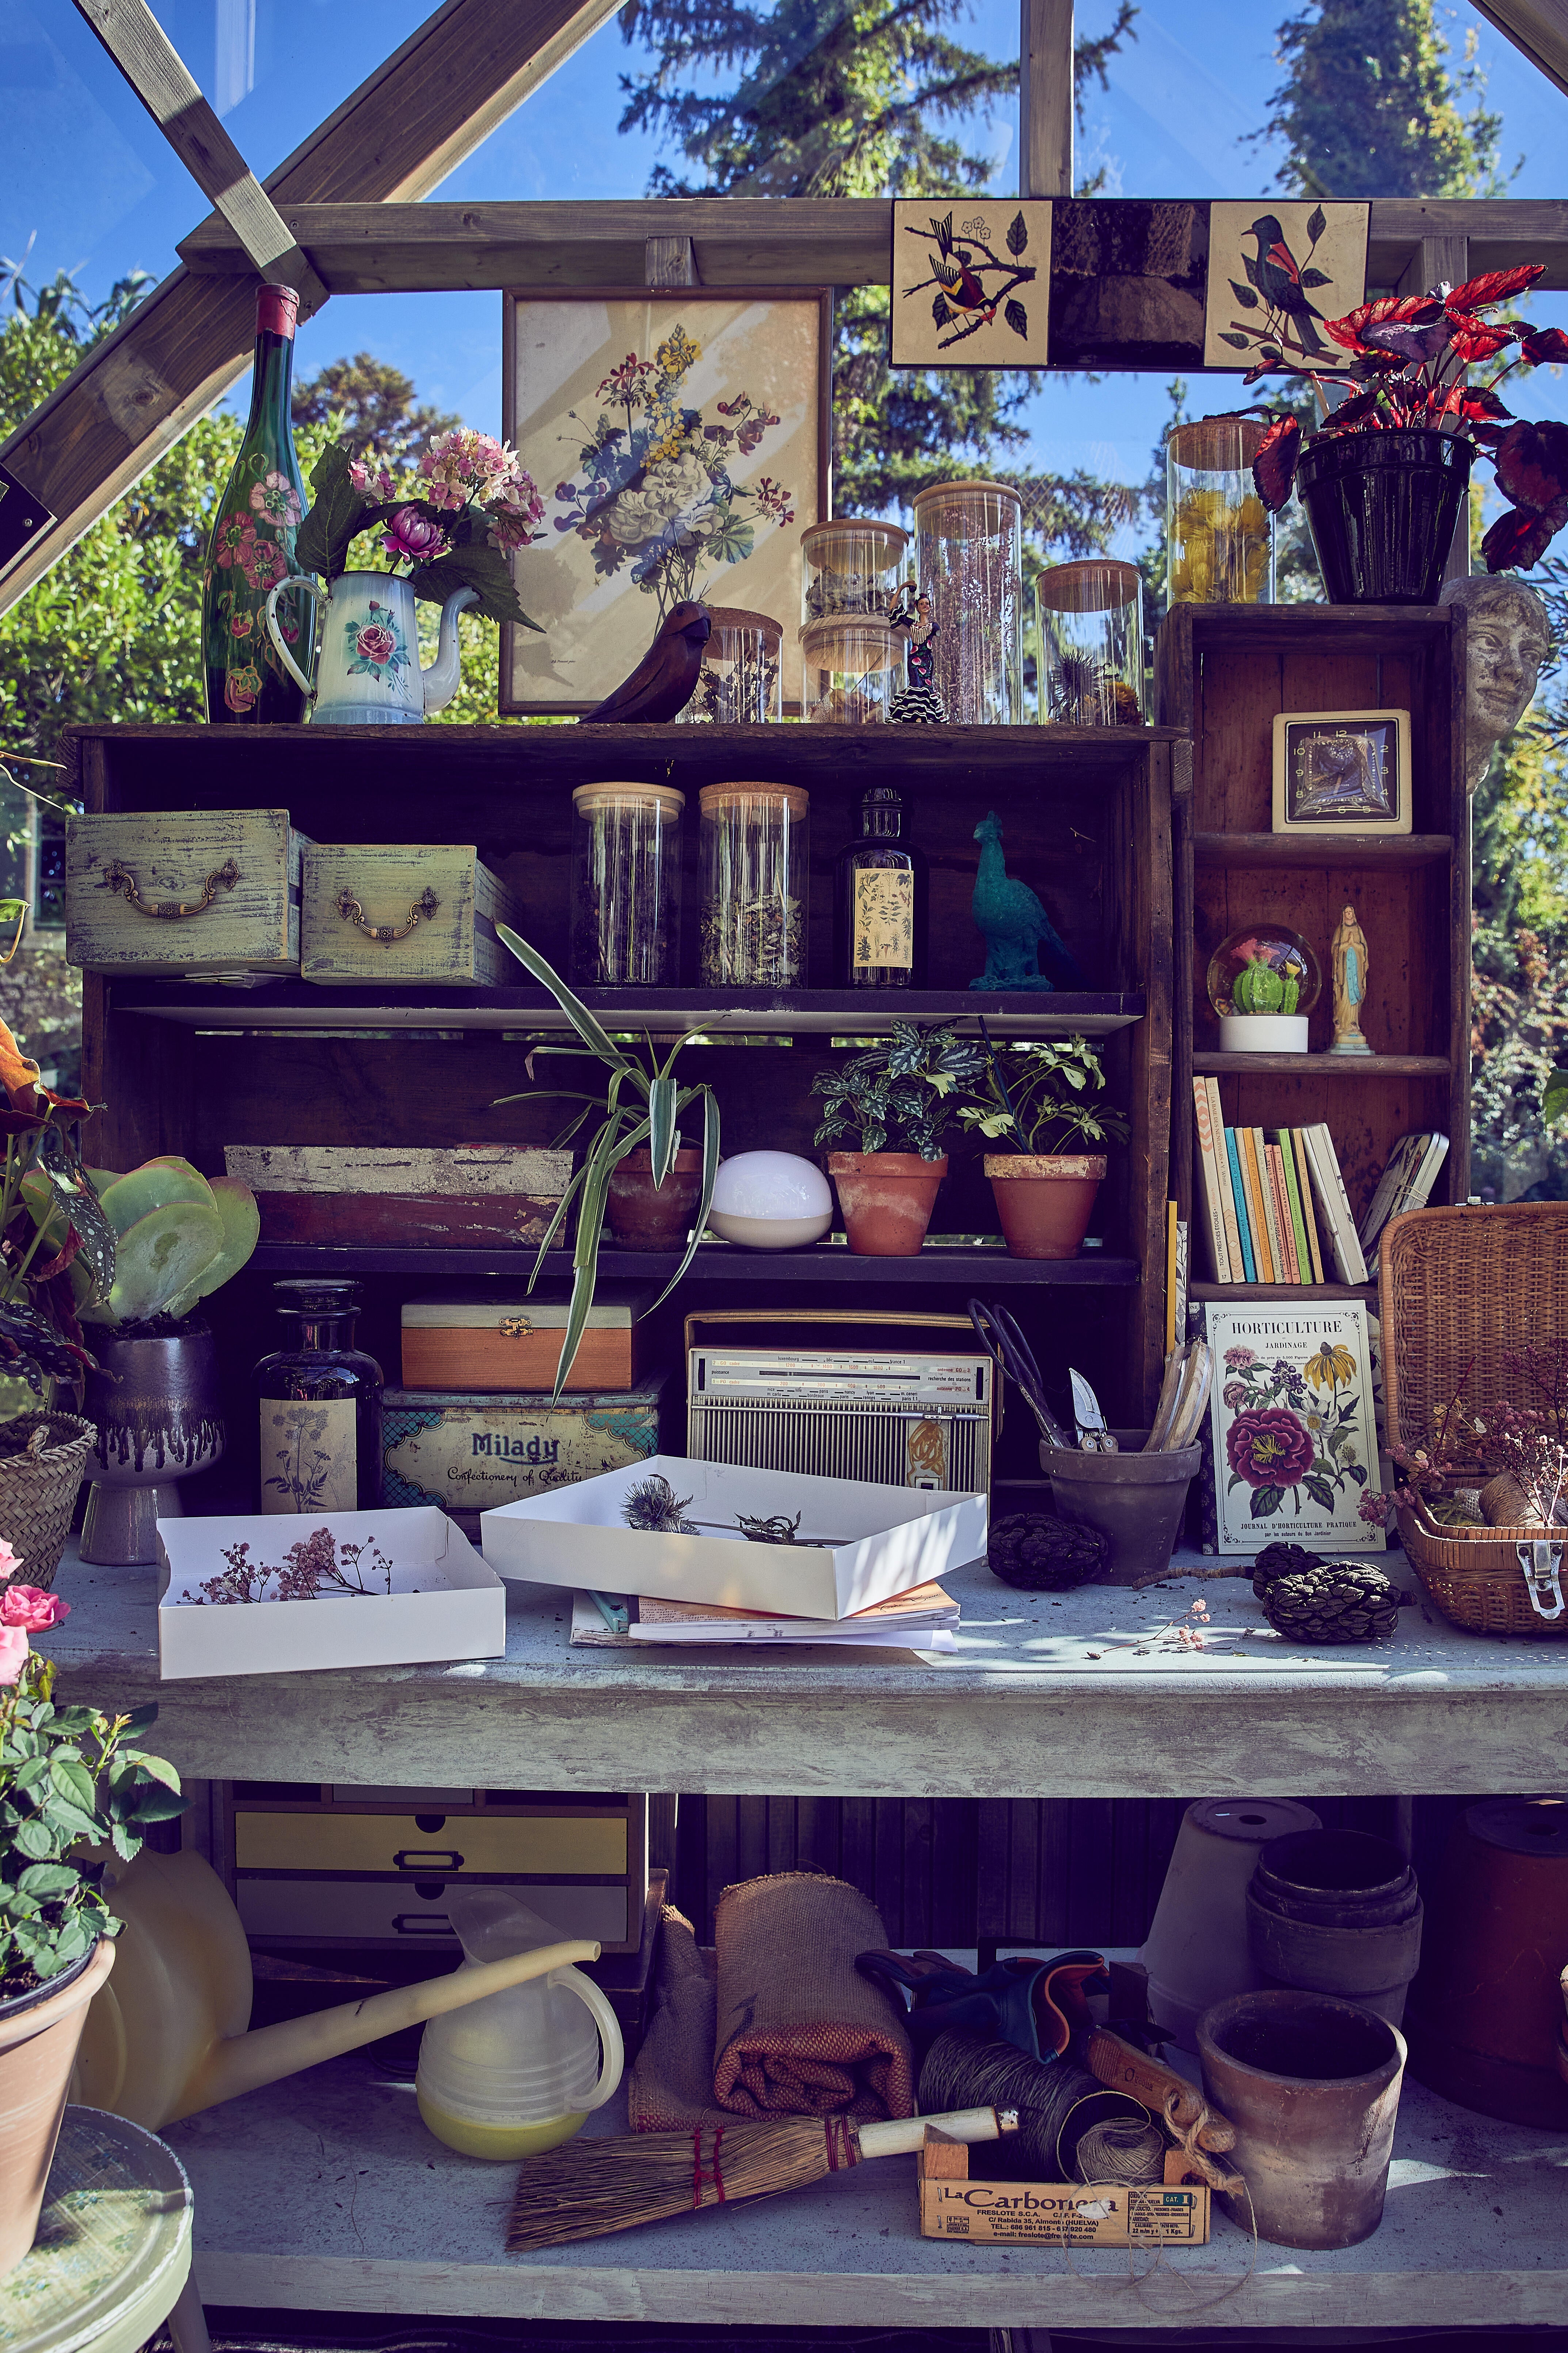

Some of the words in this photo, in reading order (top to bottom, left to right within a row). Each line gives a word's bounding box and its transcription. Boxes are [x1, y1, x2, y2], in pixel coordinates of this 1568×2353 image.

[1232, 1321, 1341, 1334] HORTICULTURE
[471, 1432, 560, 1465] Milady
[448, 1467, 517, 1487] Confectionery
[523, 1469, 533, 1486] of
[539, 1469, 582, 1484] Quality
[944, 2187, 964, 2198] La
[964, 2189, 1119, 2211] Carbonea
